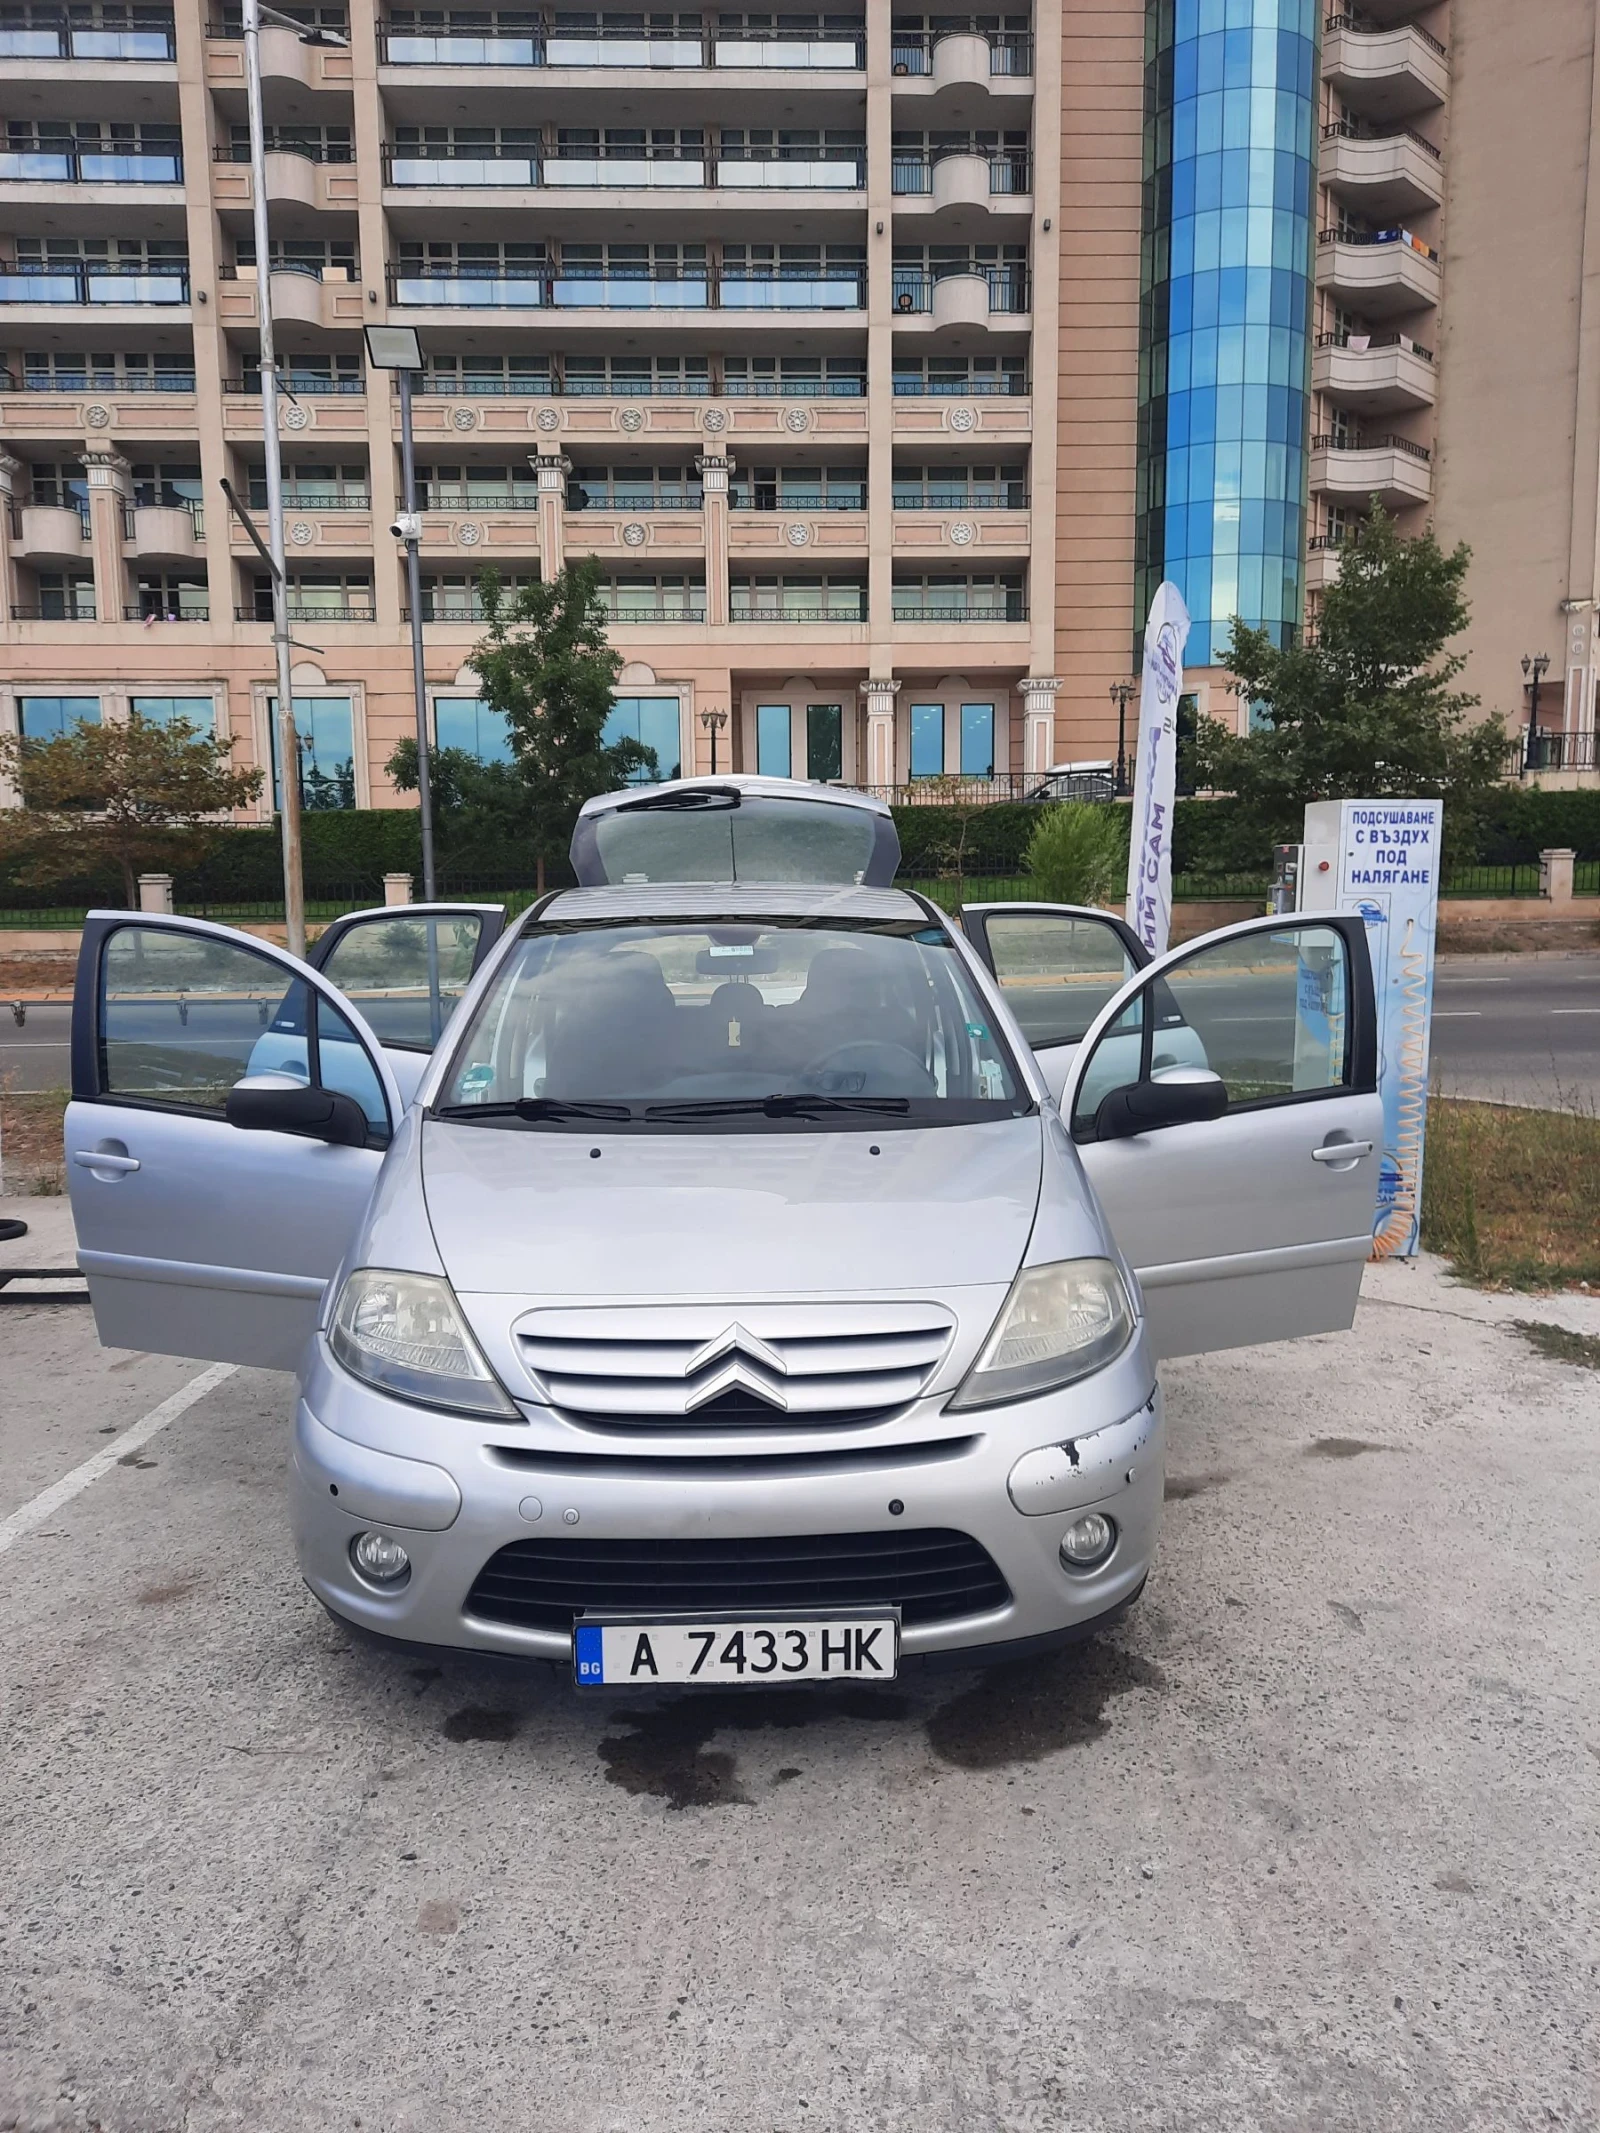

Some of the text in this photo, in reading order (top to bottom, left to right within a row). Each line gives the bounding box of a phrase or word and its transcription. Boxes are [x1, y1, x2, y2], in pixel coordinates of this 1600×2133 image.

[1352, 811, 1434, 827] ПОДСУШАВАНЕ
[1147, 803, 1165, 883] САМ
[1355, 829, 1429, 846] С ВЪЗДУХ
[1376, 850, 1407, 866] ПОД
[1351, 870, 1429, 884] НАЛЯГАНЕ
[630, 1633, 659, 1675] A
[580, 1661, 601, 1675] BG
